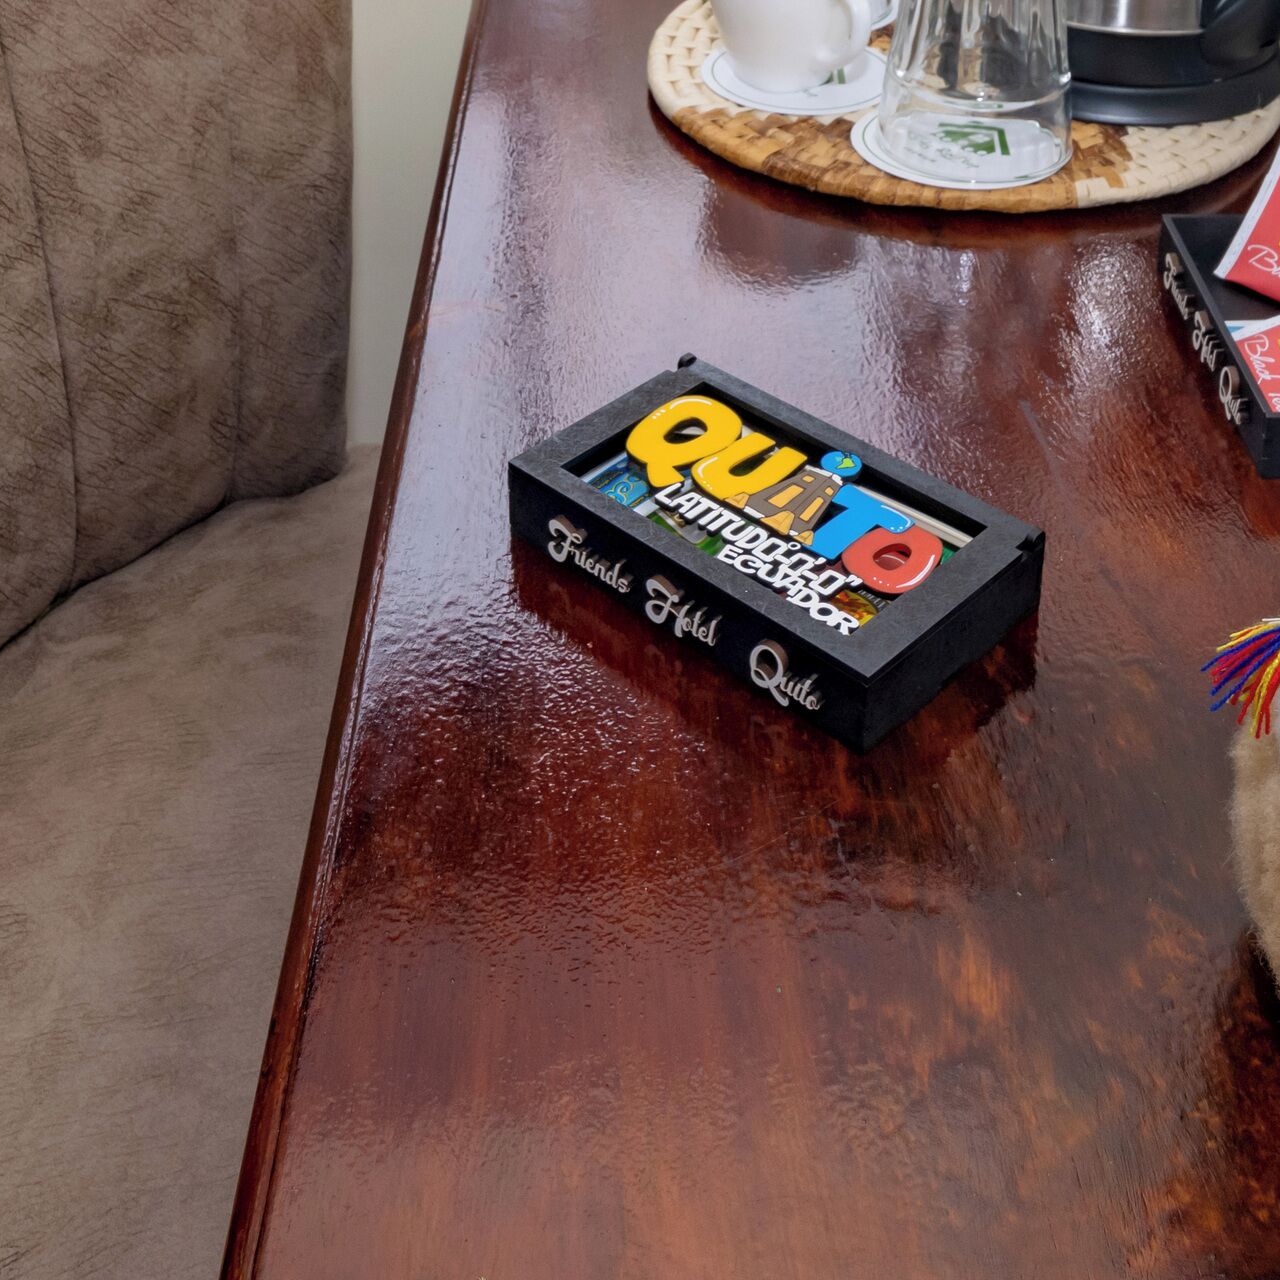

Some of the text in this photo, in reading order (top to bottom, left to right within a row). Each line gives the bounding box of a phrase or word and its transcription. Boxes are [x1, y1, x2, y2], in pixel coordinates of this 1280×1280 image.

[548, 516, 821, 710] Friends Hotel Quito
[717, 545, 860, 636] ECUADOR
